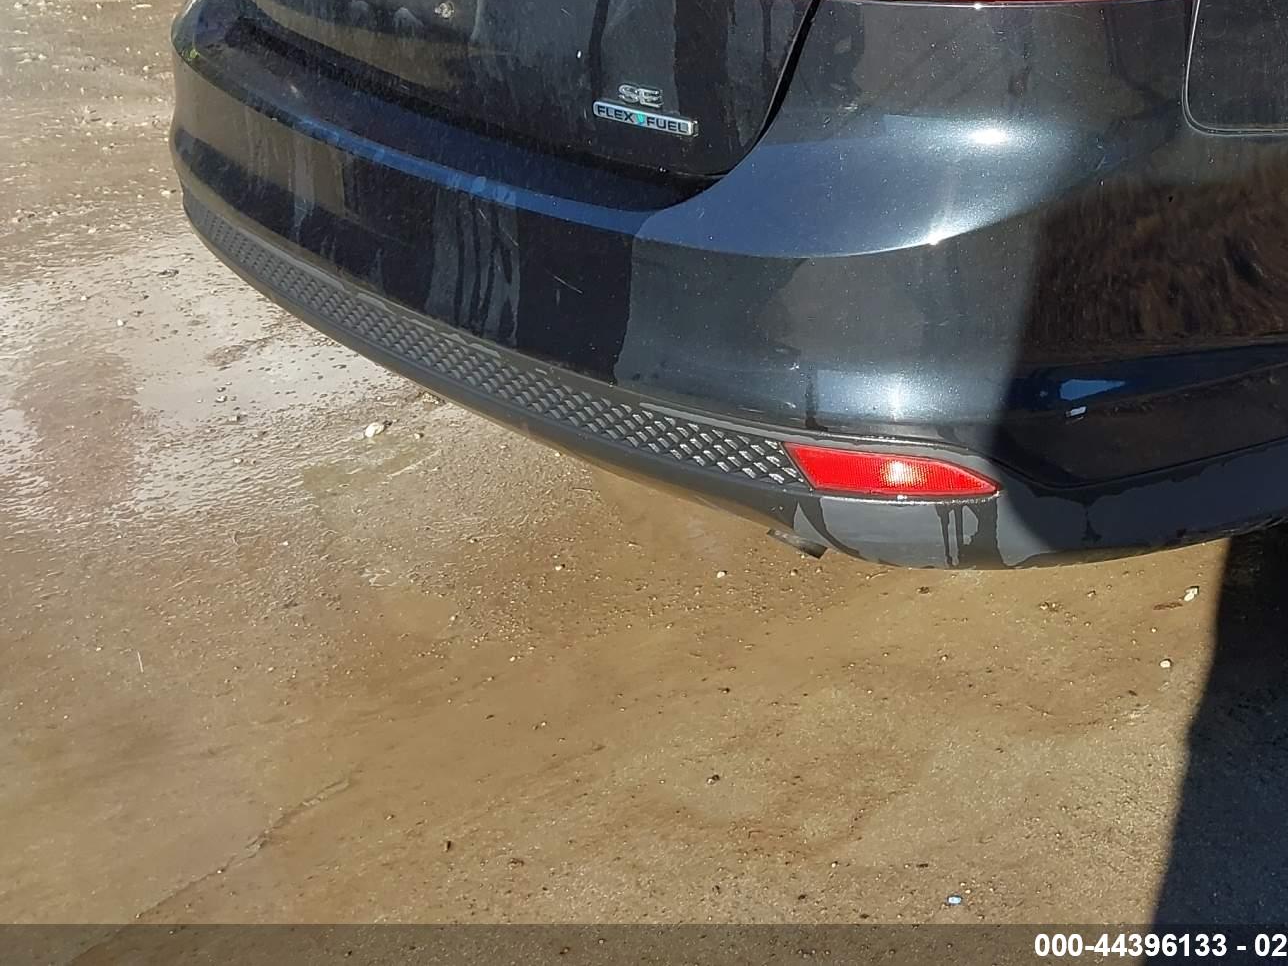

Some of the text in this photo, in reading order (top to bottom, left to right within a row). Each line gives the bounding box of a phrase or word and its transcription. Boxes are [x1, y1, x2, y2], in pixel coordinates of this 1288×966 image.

[618, 84, 663, 108] SE
[597, 105, 688, 133] FLEX FUEL
